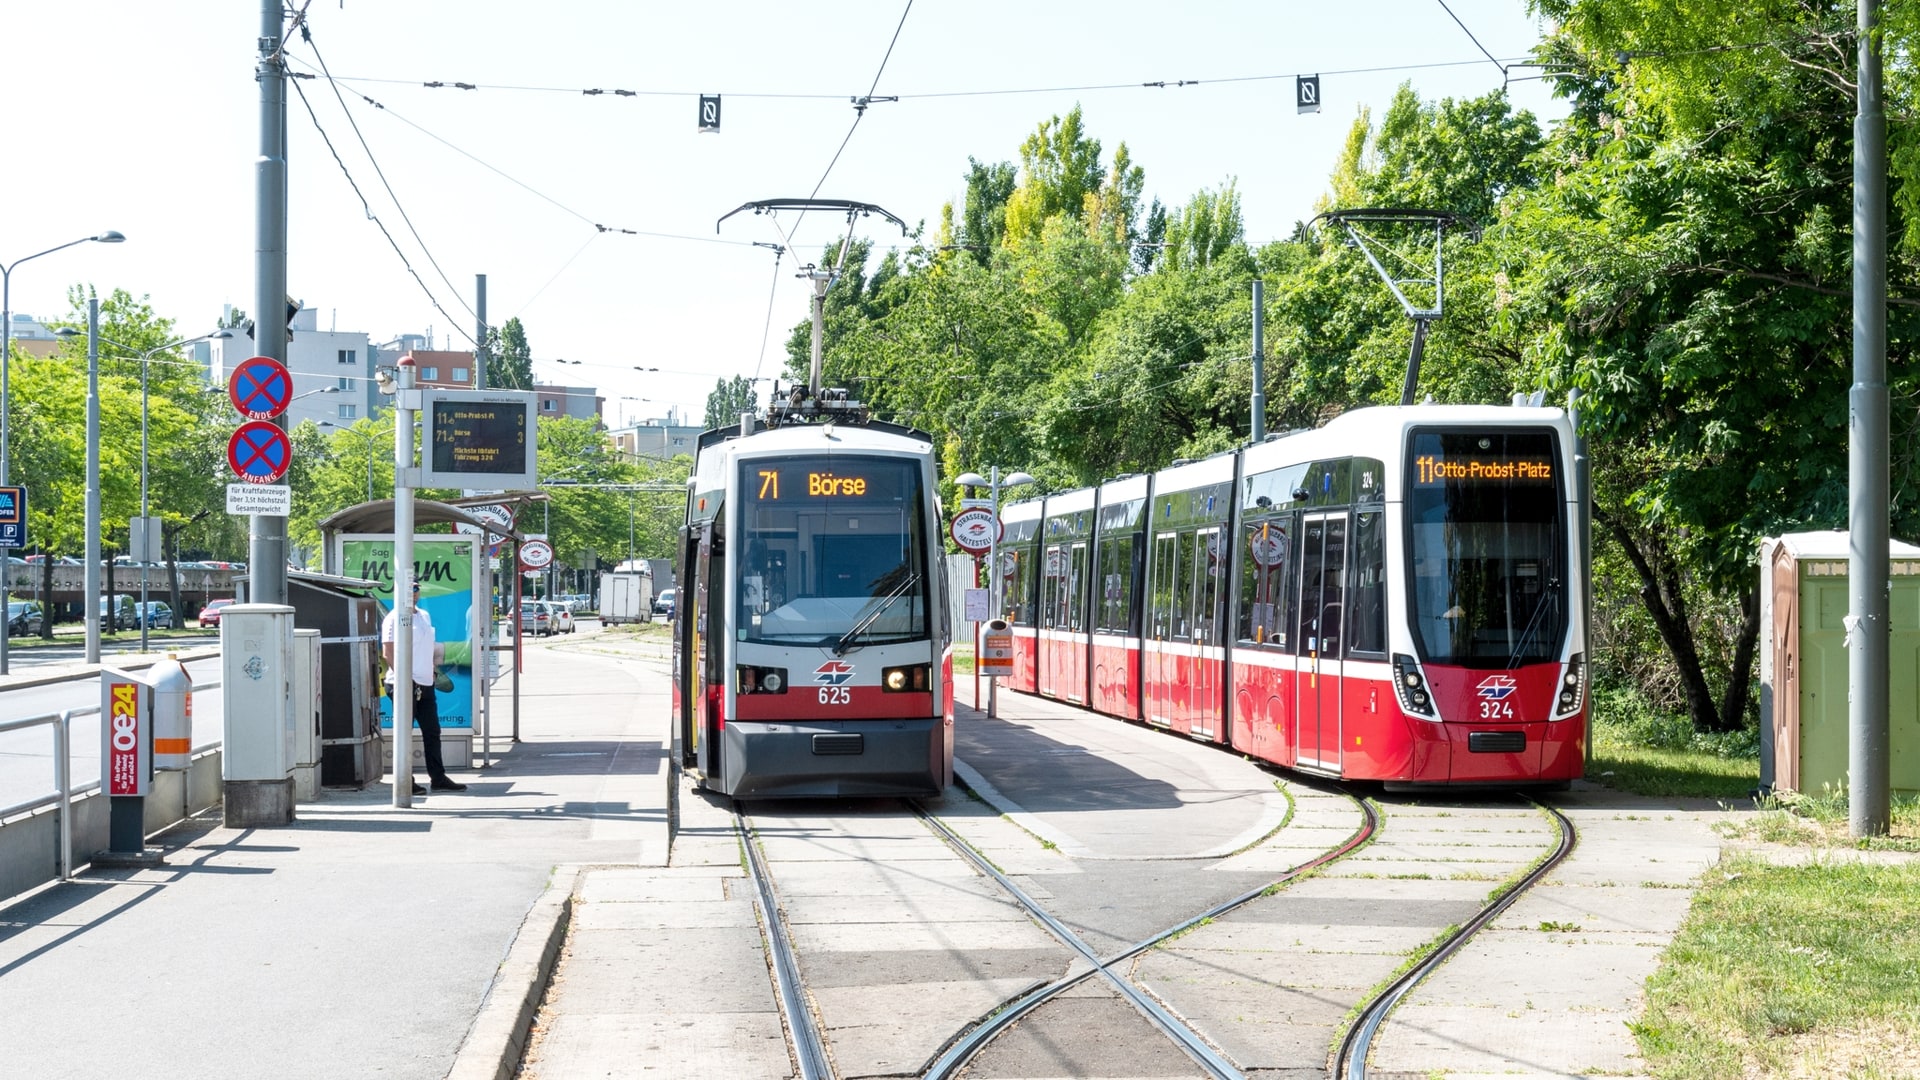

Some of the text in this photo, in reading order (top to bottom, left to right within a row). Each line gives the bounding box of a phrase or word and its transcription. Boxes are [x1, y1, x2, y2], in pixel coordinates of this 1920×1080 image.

[248, 410, 273, 420] ENDE
[436, 412, 447, 425] 11
[517, 414, 524, 426] 3
[436, 430, 447, 442] 71
[517, 432, 524, 443] 3
[1416, 456, 1551, 484] 11 Otto-Probst-Platz
[241, 472, 277, 484] ANFANG
[1362, 471, 1374, 489] 324
[231, 486, 287, 497] für Kraftfahrzeuge
[758, 471, 866, 500] 71 Börse
[235, 505, 281, 513] Gesamtgewicht
[956, 513, 993, 527] STRASSENBA
[7, 527, 14, 535] P
[372, 549, 389, 558] Sag
[818, 687, 850, 704] 625
[1480, 702, 1513, 718] 324
[113, 684, 136, 751] oe24
[121, 754, 129, 772] Handy
